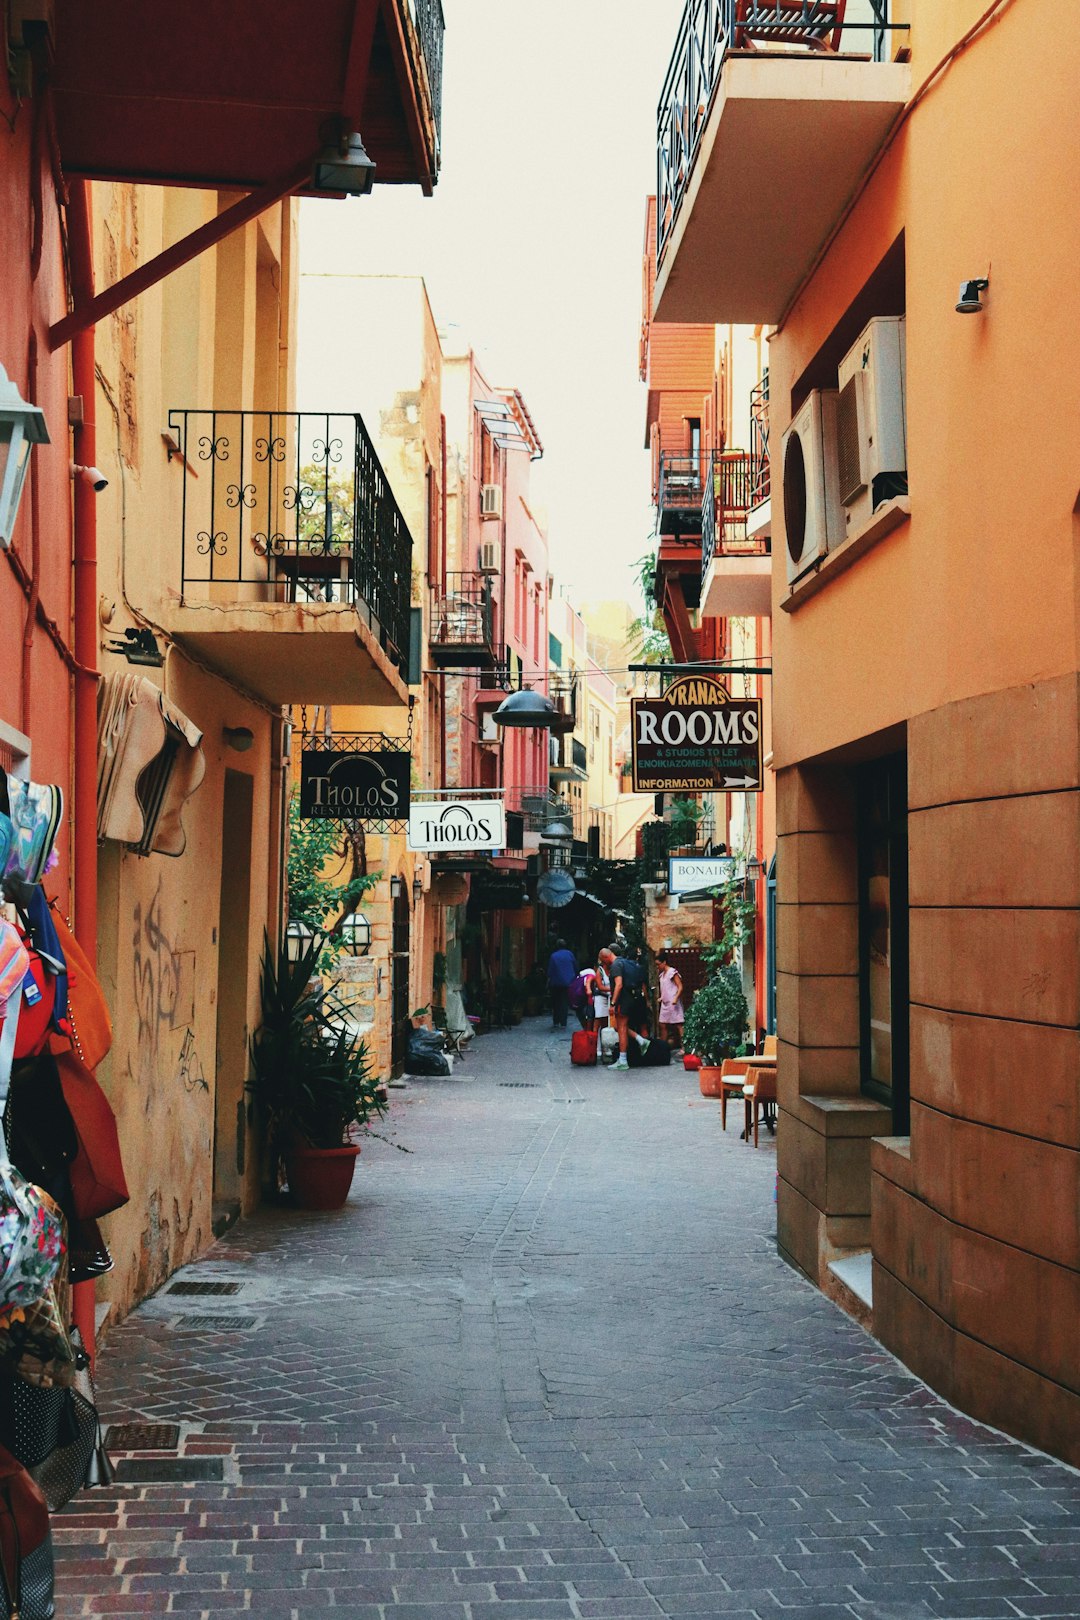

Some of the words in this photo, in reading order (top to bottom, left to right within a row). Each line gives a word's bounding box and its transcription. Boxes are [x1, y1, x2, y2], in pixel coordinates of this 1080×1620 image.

[667, 681, 726, 705] VRANAS
[637, 710, 758, 745] ROOMS
[657, 749, 663, 757] &
[665, 748, 705, 757] STUDIOS
[708, 748, 720, 757] TO
[722, 748, 738, 757] LET
[307, 776, 399, 807] THOLOS
[638, 778, 714, 788] INFORMATION
[311, 806, 400, 816] RESTAURANT
[420, 819, 492, 842] THOLOS
